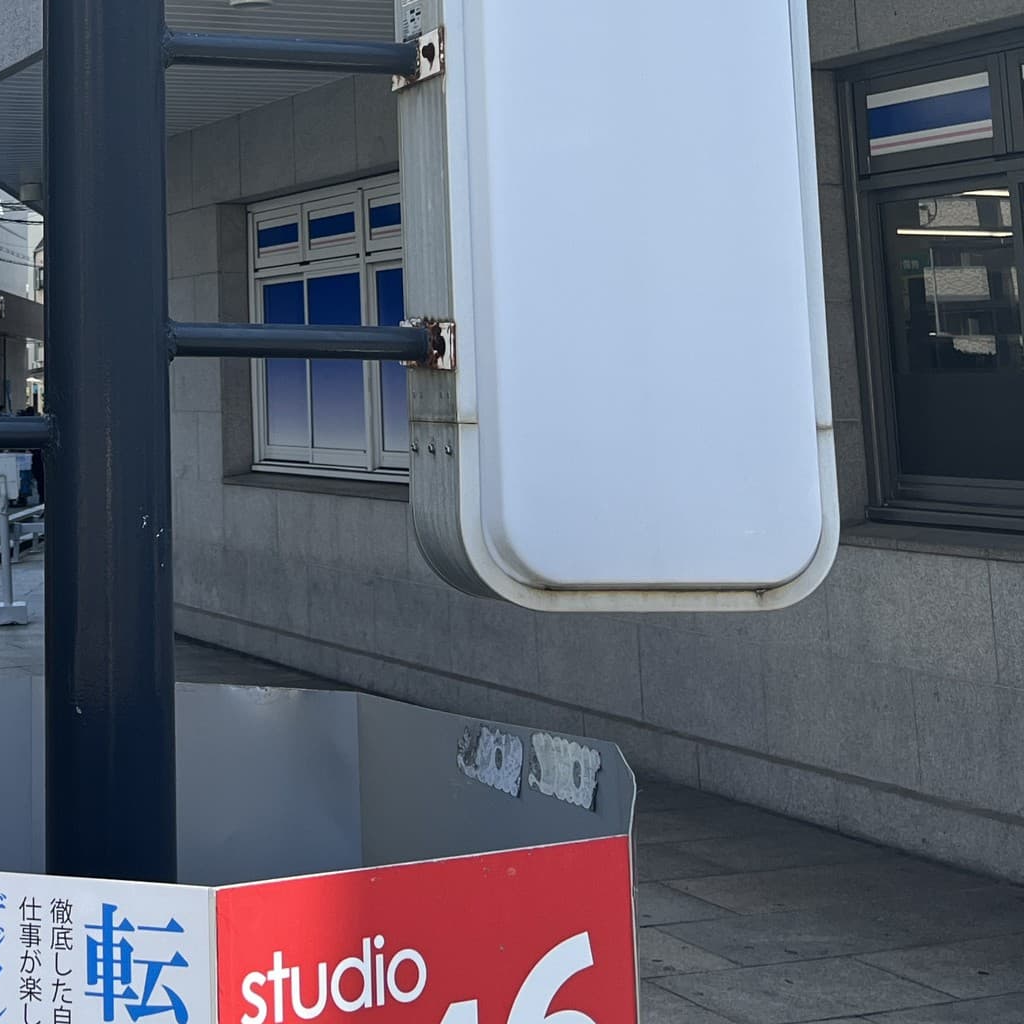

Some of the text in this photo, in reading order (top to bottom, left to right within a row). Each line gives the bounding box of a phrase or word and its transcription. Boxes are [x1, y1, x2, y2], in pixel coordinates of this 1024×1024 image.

[19, 895, 43, 1024] 仕事が楽し
[84, 902, 189, 1024] 転
[240, 934, 428, 1024] studio
